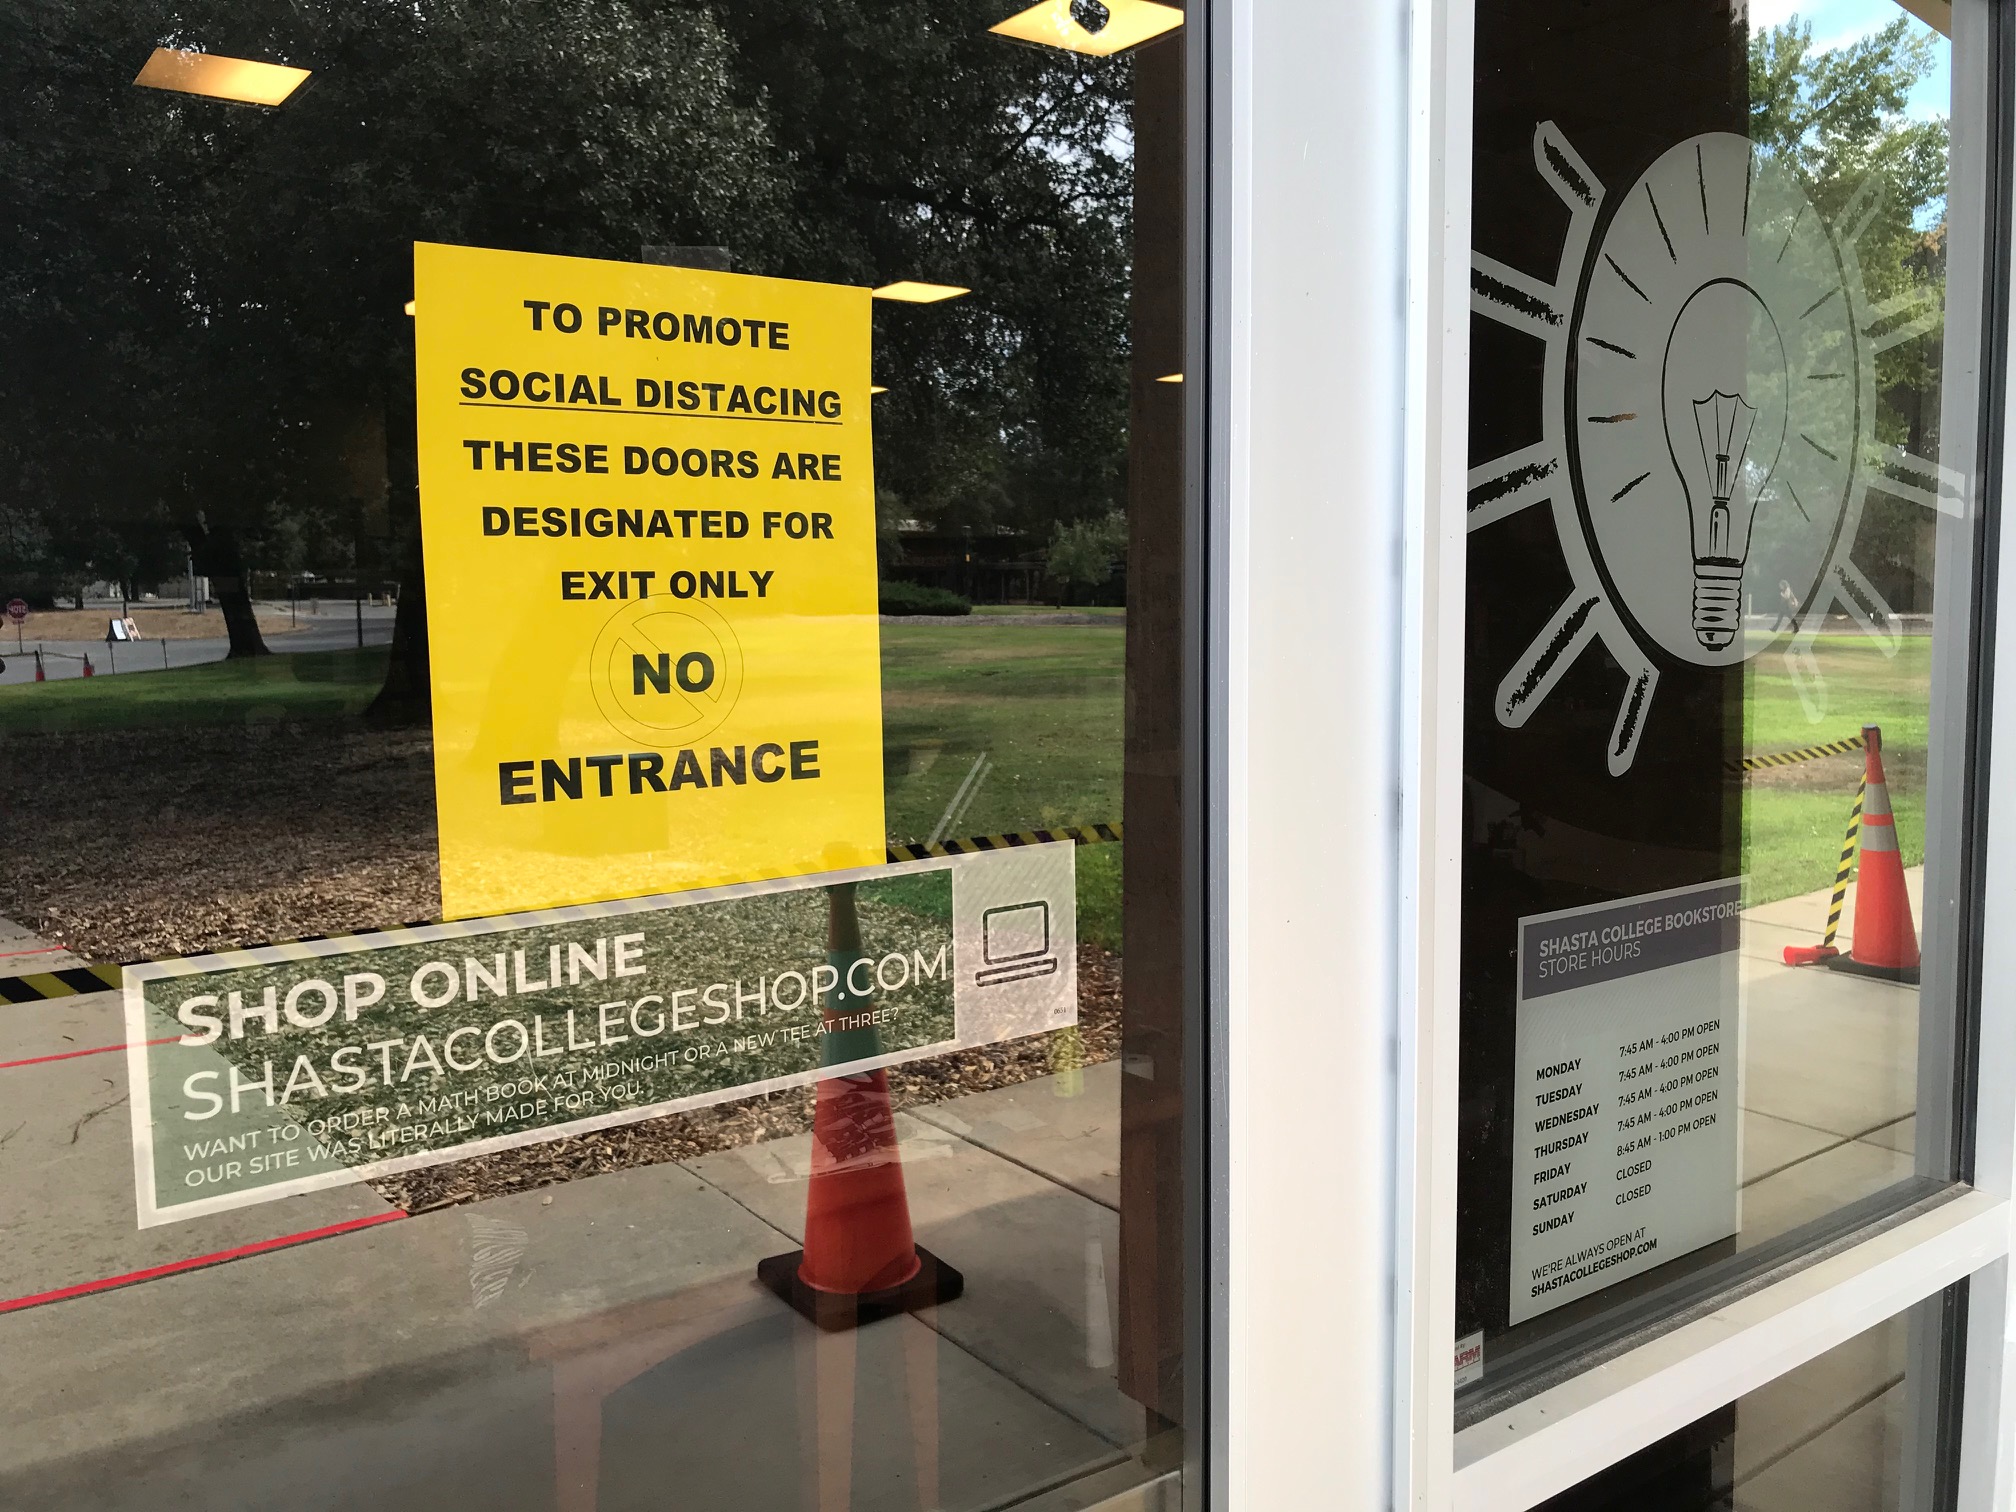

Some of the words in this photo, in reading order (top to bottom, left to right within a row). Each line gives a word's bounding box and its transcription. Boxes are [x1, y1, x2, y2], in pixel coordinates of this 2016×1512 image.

[524, 300, 582, 333] TO
[598, 306, 790, 350] PROMOTE
[460, 367, 622, 405] SOCIAL
[636, 378, 842, 418] DISTACING
[463, 440, 608, 474] THESE
[624, 446, 758, 479] DOORS
[771, 452, 842, 481] ARE
[482, 506, 749, 539] DESIGNATED
[763, 512, 834, 540] FOR
[561, 571, 655, 600] EXIT
[670, 570, 775, 599] ONLY
[633, 651, 714, 695] NO
[499, 740, 821, 806] ENTRANCE
[1540, 930, 1599, 957] SHASTA
[1602, 917, 1662, 944] COLLEGE
[1665, 900, 1741, 931] BOOKSTORE
[1539, 952, 1587, 978] STORE
[1592, 940, 1641, 967] HOURS
[177, 972, 386, 1048] SHOP
[410, 932, 646, 1008] ONLINE
[183, 944, 947, 1121] SHASTACOLLEGESHOP.COM
[1536, 1058, 1582, 1081] MONDAY
[1620, 1043, 1637, 1057] 7:45
[1639, 1038, 1653, 1052] AM
[1661, 1031, 1680, 1045] 4:00
[1682, 1026, 1694, 1039] PM
[1696, 1019, 1720, 1034] OPEN
[183, 1130, 261, 1161] WANT
[267, 1123, 300, 1143] TO
[307, 1107, 390, 1136] ORDER
[396, 1103, 413, 1119] A
[418, 1088, 479, 1114] MATH
[486, 1076, 550, 1100] BOOK
[553, 1071, 578, 1087] AT
[583, 1051, 679, 1083] MIDNIGHT
[684, 1043, 711, 1062] OR
[715, 1041, 729, 1057] A
[734, 1030, 775, 1053] NEW
[780, 1025, 810, 1043] TEE
[811, 1019, 835, 1037] AT
[838, 1007, 899, 1031] THREE?
[1534, 1103, 1600, 1133] WEDNESDAY
[1618, 1092, 1636, 1107] 7:45
[1637, 1087, 1652, 1101] AM
[1659, 1079, 1678, 1093] 4:00
[1680, 1074, 1693, 1087] PM
[1695, 1066, 1719, 1082] OPEN
[1535, 1083, 1583, 1107] TUESDAY
[1619, 1067, 1637, 1082] 7:45
[1638, 1062, 1652, 1076] AM
[1660, 1055, 1679, 1069] 4:00
[1681, 1050, 1694, 1063] PM
[1696, 1043, 1719, 1058] OPEN
[184, 1160, 242, 1188] OUR
[249, 1150, 299, 1175] SITE
[307, 1137, 361, 1162] WAS
[368, 1113, 479, 1150] LITERALLY
[486, 1100, 546, 1125] MADE
[554, 1091, 594, 1111] FOR
[599, 1080, 644, 1101] YOU.
[1533, 1163, 1571, 1185] FRIDAY
[1616, 1141, 1635, 1156] 8:45
[1637, 1135, 1651, 1150] AM
[1659, 1127, 1676, 1142] 1:00
[1678, 1122, 1691, 1135] PM
[1692, 1113, 1716, 1130] OPEN
[1534, 1132, 1589, 1159] THURSDAY
[1617, 1116, 1635, 1131] 7:45
[1637, 1111, 1652, 1125] AM
[1659, 1103, 1678, 1117] 4:00
[1680, 1098, 1693, 1111] PM
[1694, 1090, 1718, 1106] OPEN
[1532, 1211, 1575, 1236] SUNDAY
[1615, 1184, 1652, 1206] CLOSED
[1533, 1182, 1588, 1211] SATURDAY
[1616, 1160, 1652, 1181] CLOSED
[1531, 1238, 1657, 1297] SHASTACOLLEGESHOP.COM
[1532, 1259, 1563, 1281] WE'RE
[1565, 1243, 1605, 1268] ALWAYS
[1606, 1232, 1632, 1251] OPEN
[1634, 1227, 1646, 1241] AT
